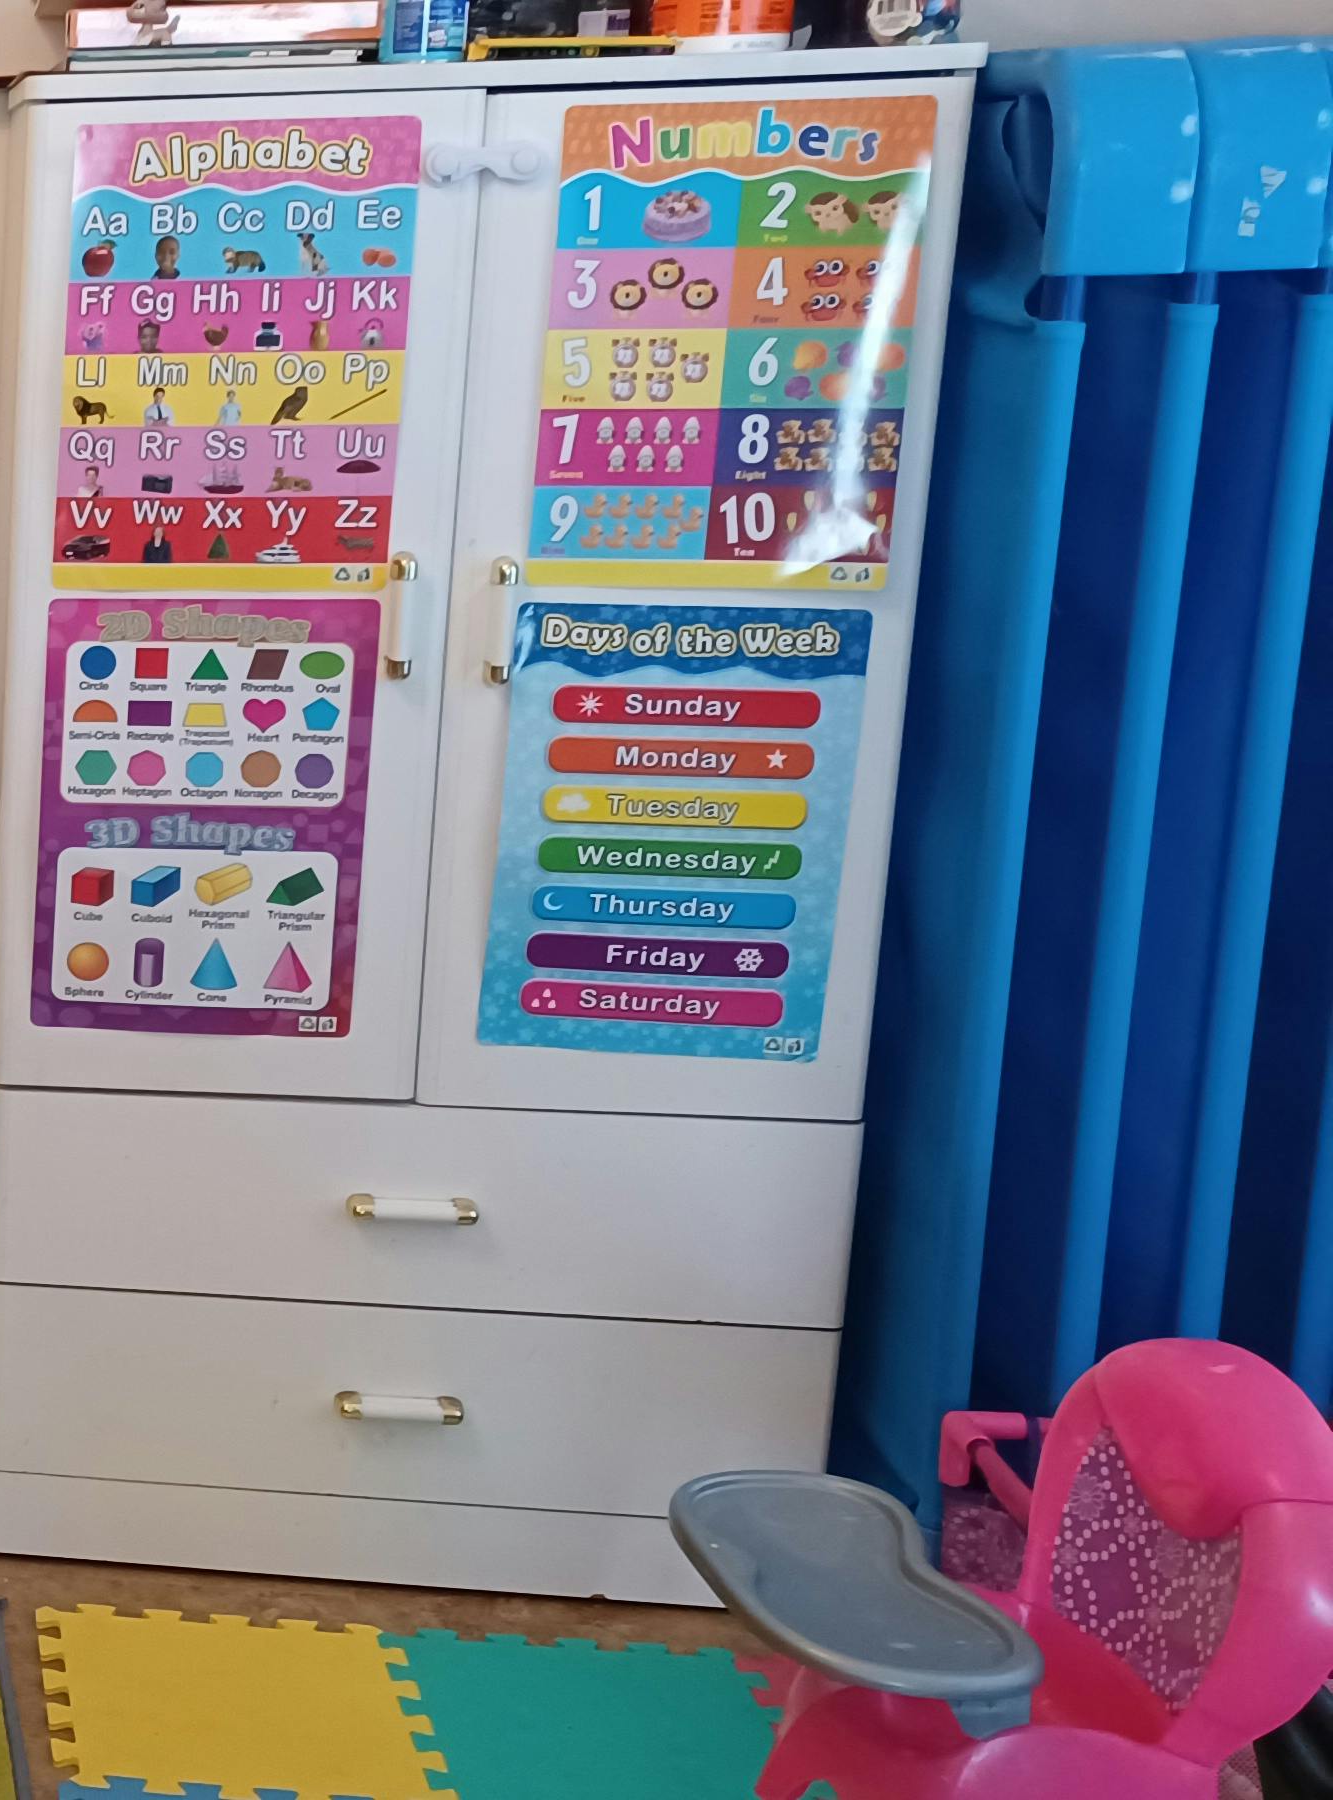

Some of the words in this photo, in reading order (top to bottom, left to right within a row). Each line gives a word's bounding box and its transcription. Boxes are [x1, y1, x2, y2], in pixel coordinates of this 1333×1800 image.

[610, 108, 879, 169] Numbers
[131, 128, 371, 184] Alphabet
[83, 207, 128, 236] Aa
[150, 204, 197, 234] Bb
[218, 204, 264, 234] Cc
[286, 201, 333, 230] Dd
[357, 200, 401, 229] Ee
[584, 185, 601, 230] 1
[760, 182, 796, 228] 2
[568, 259, 600, 308] 3
[757, 256, 788, 305] 4
[80, 285, 114, 316] Ff
[131, 285, 174, 321] Gg
[192, 284, 240, 313] Hh
[261, 283, 281, 312] Ii
[305, 282, 334, 318] Jj
[352, 281, 397, 310] Kk
[76, 358, 105, 387] Ll
[137, 357, 187, 387] Mm
[209, 356, 256, 385] Nn
[275, 355, 325, 385] Oo
[343, 353, 388, 389] Pp
[563, 337, 591, 388] 5
[749, 337, 778, 386] 6
[69, 431, 114, 466] Qq
[140, 431, 180, 461] Rr
[204, 430, 246, 460] Ss
[271, 429, 306, 458] Tt
[337, 429, 384, 459] Uu
[552, 414, 579, 464] 7
[738, 414, 769, 464] 8
[70, 501, 112, 529] Vv
[133, 500, 183, 526] Ww
[202, 500, 242, 529] Xx
[266, 500, 306, 535] Yy
[335, 500, 377, 528] Zz
[550, 495, 578, 541] 9
[719, 492, 775, 544] 10
[98, 611, 150, 641] 2D
[162, 604, 310, 647] Shapes
[542, 615, 627, 652] Days
[631, 622, 670, 656] of
[676, 626, 733, 657] the
[742, 624, 838, 656] Week
[79, 682, 109, 691] Circle
[130, 683, 167, 692] Square
[185, 683, 227, 693] Triangle
[241, 683, 293, 693] Rhombus
[316, 684, 340, 693] Oval
[624, 695, 741, 721] Sunday
[69, 731, 120, 740] Semi-Circle
[127, 732, 174, 742] Rectangle
[248, 733, 279, 742] Heart
[293, 734, 343, 744] Pentagon
[615, 747, 735, 774] Monday
[68, 787, 116, 797] Hexagon
[122, 787, 171, 798] Heptagon
[181, 788, 227, 798] Octagon
[235, 789, 282, 799] Nonagon
[292, 790, 338, 800] Decagon
[607, 795, 739, 823] Tuesday
[85, 818, 139, 848] 3D
[151, 813, 295, 855] Shapes
[577, 846, 756, 876] Wednesday
[74, 912, 102, 921] Cube
[132, 914, 172, 923] Cuboid
[189, 910, 249, 920] Hexagonal
[268, 911, 325, 921] Triangular
[590, 894, 733, 924] Thursday
[201, 921, 235, 929] Prism
[279, 922, 312, 931] Prism
[607, 944, 705, 972] Friday
[65, 987, 103, 997] Sphere
[125, 990, 173, 1001] Cylinder
[197, 993, 226, 1002] Cone
[264, 995, 312, 1005] Pyramid
[579, 989, 720, 1019] Saturday
